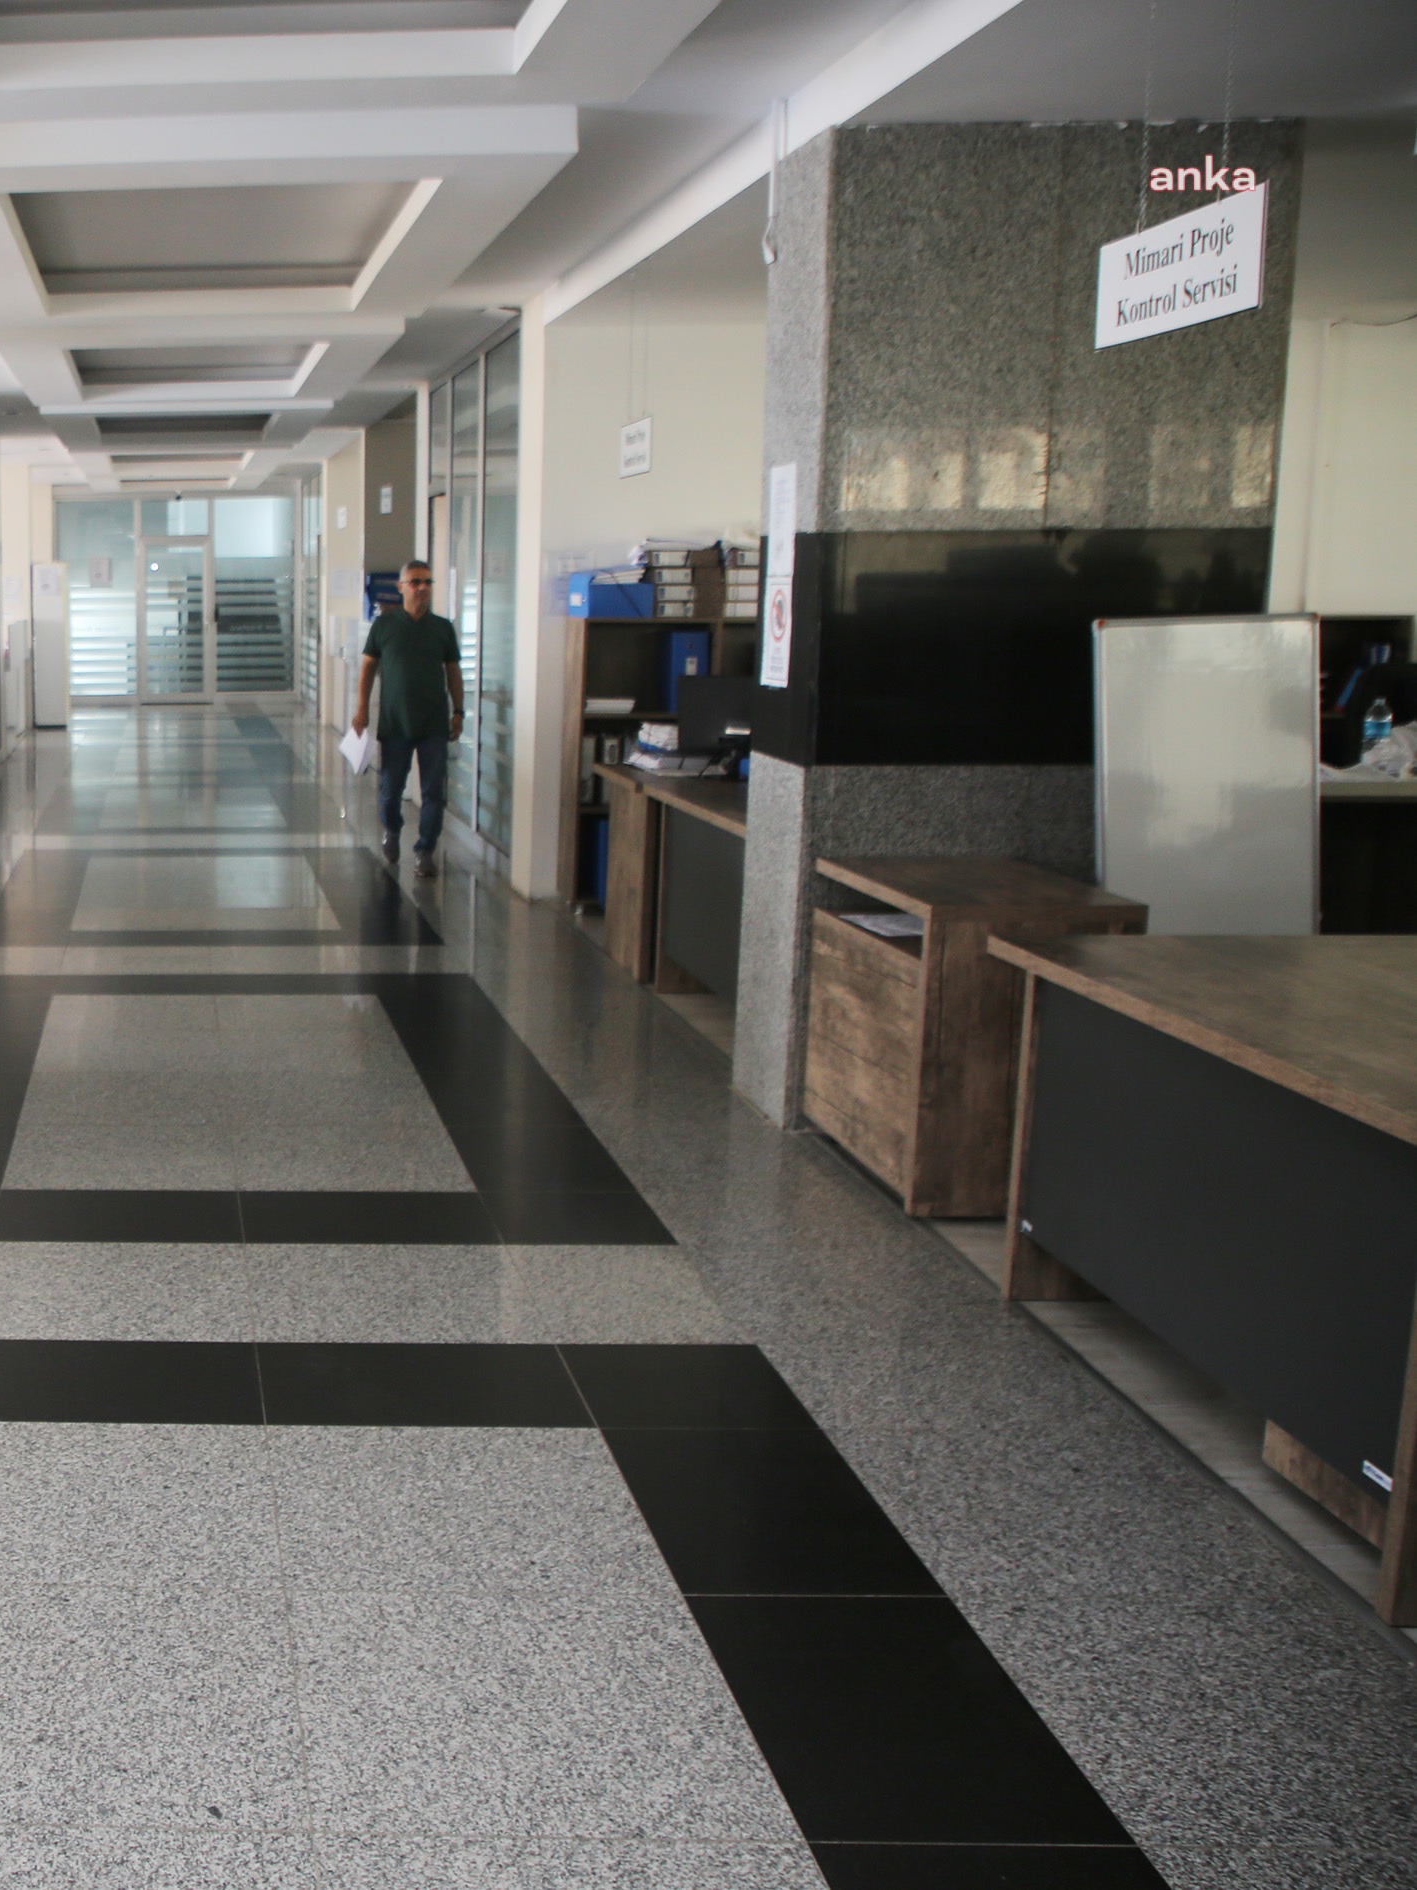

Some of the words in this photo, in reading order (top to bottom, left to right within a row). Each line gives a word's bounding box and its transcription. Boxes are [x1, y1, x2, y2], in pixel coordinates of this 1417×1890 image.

[1123, 232, 1184, 280] Mimari
[1189, 217, 1235, 257] Proje
[1116, 283, 1178, 327] Kontrol
[1182, 263, 1238, 309] Servisi
